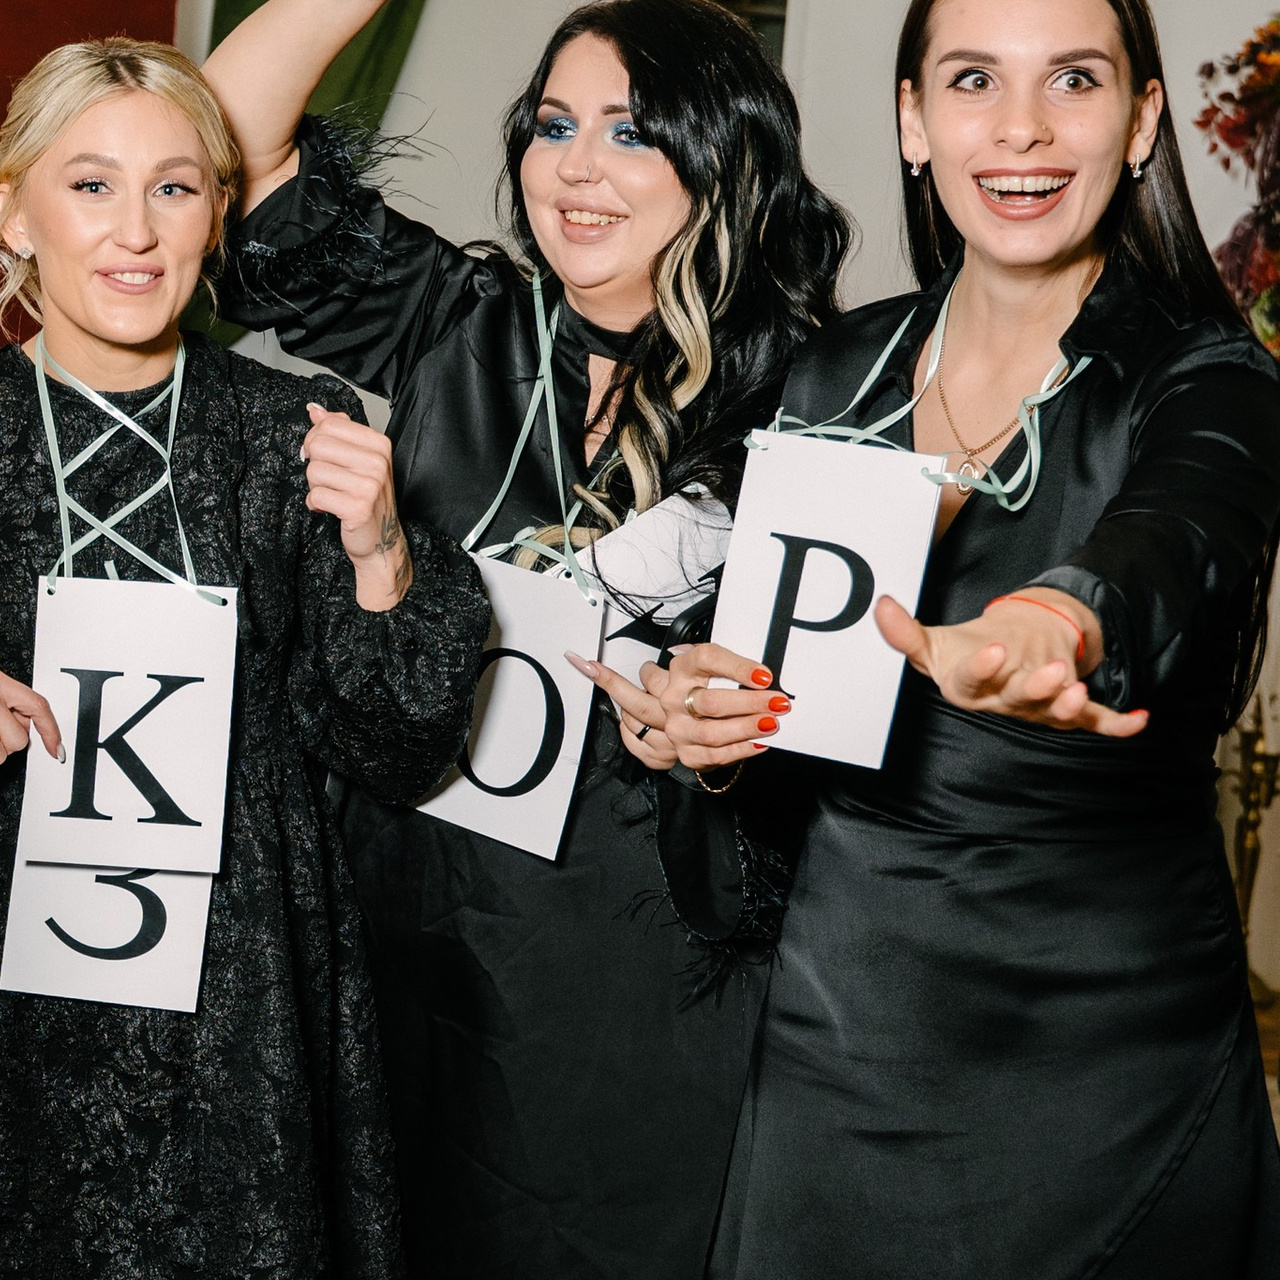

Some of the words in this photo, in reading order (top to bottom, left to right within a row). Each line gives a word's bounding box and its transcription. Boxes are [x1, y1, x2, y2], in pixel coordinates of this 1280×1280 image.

[738, 531, 876, 700] P
[49, 667, 205, 827] K
[457, 647, 565, 797] O
